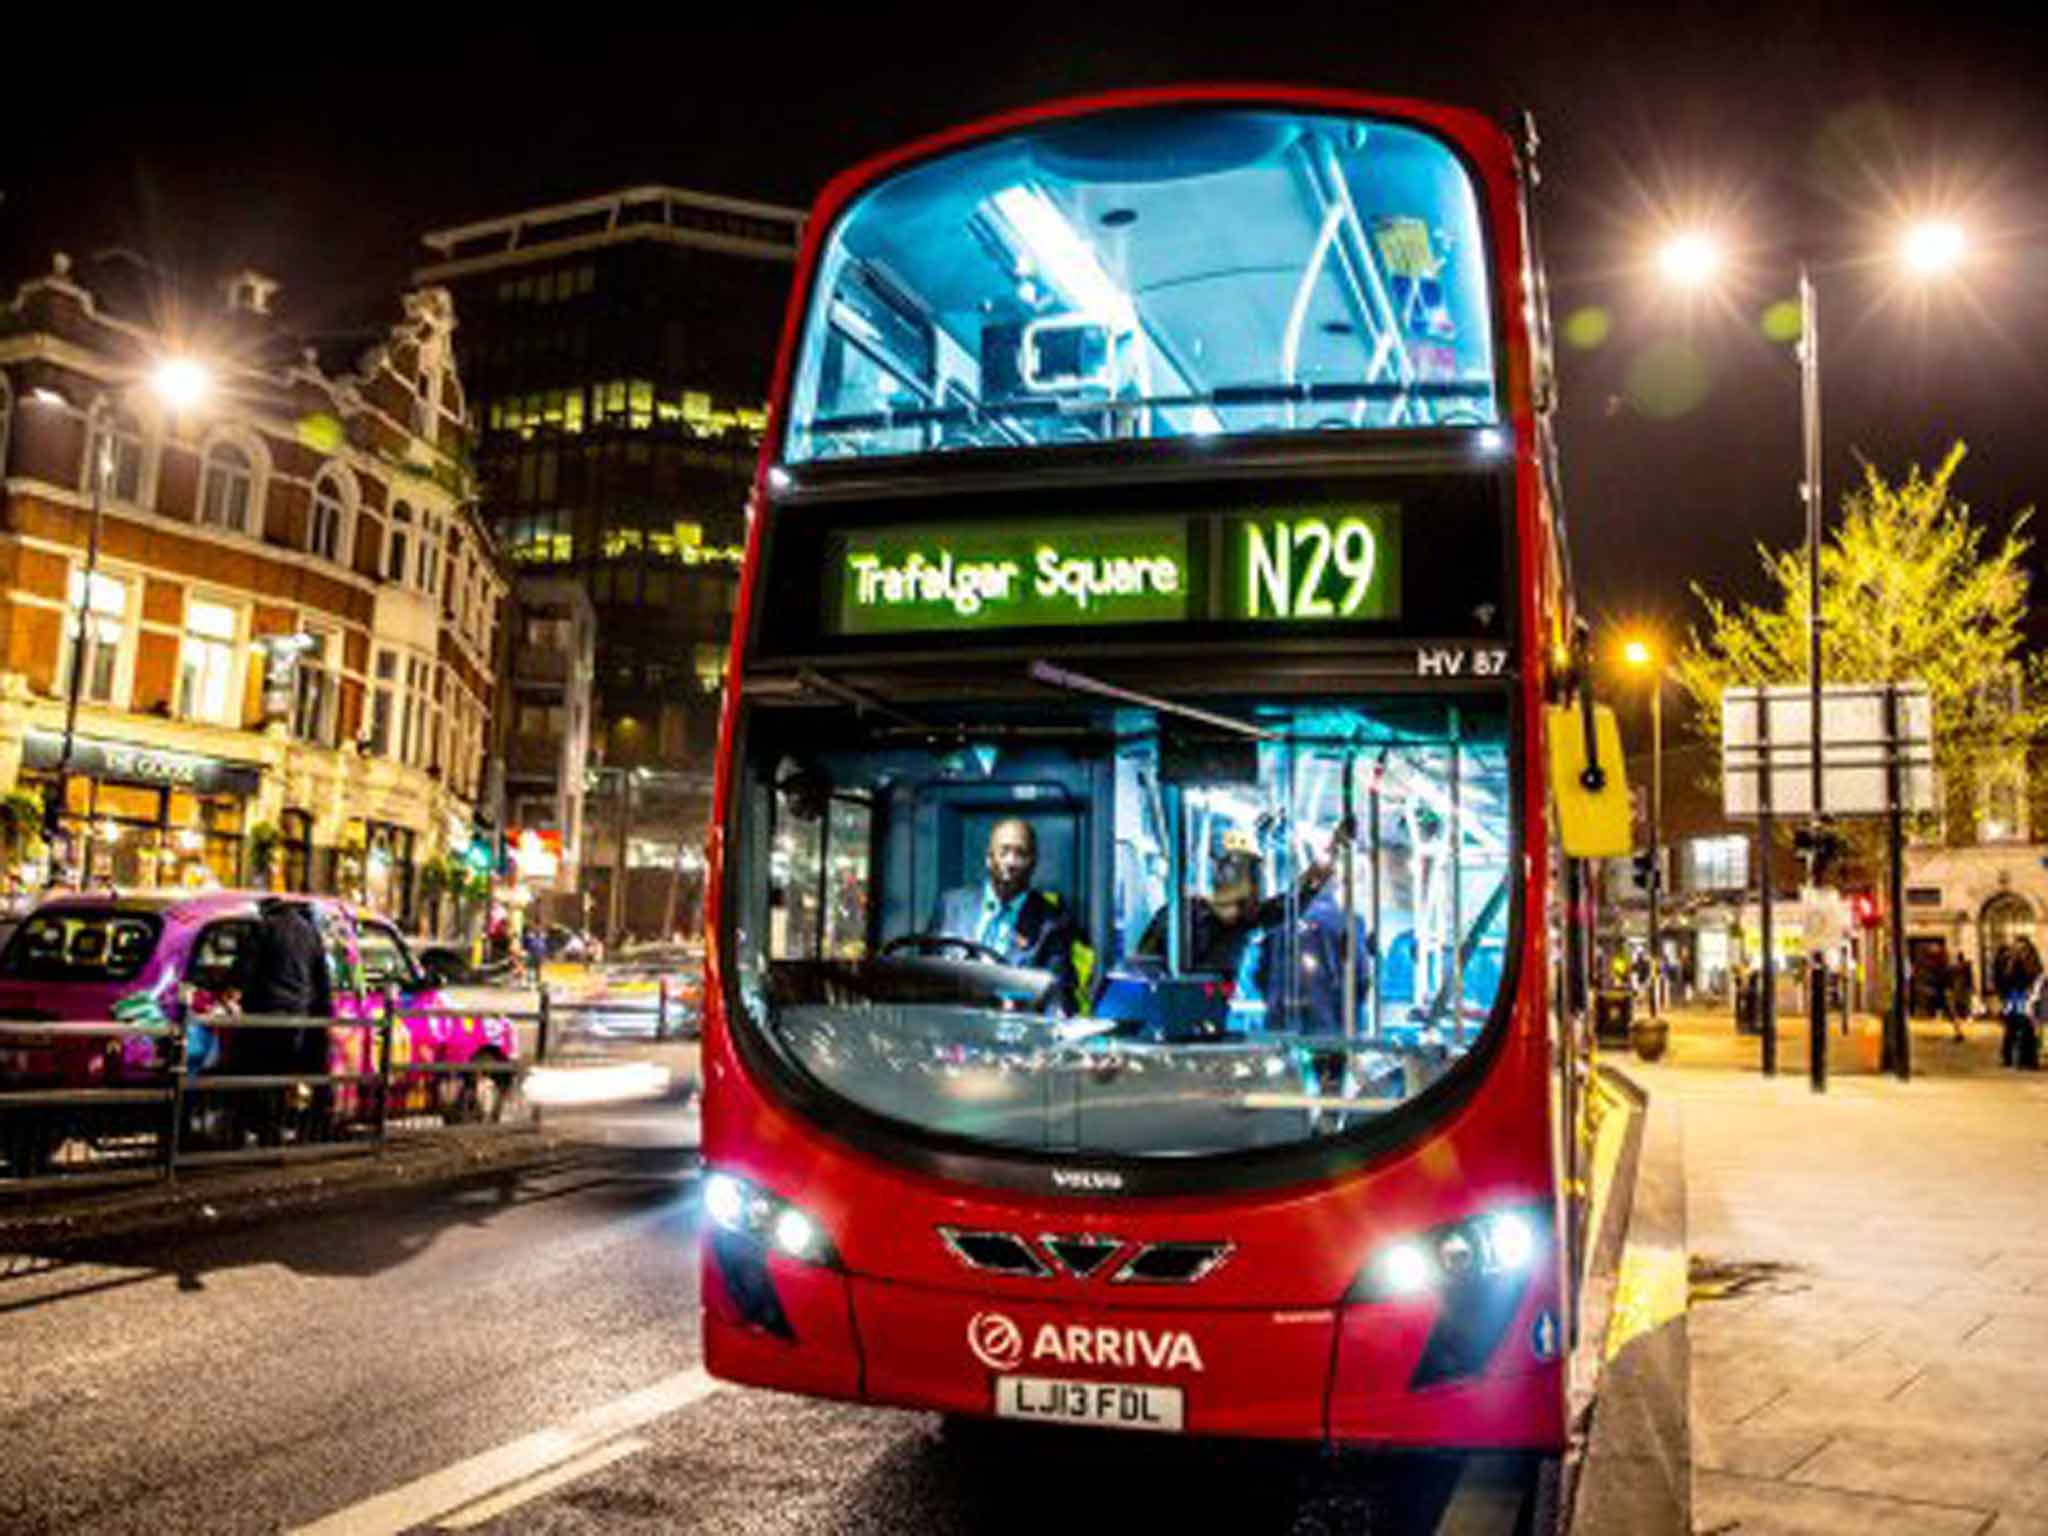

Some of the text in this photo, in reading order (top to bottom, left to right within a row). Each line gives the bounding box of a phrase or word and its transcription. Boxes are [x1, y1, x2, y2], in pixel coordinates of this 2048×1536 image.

[849, 518, 1377, 618] Trafalgar Square N29
[1417, 648, 1464, 676] HV
[1032, 1323, 1204, 1372] ARRIVA
[1015, 1377, 1161, 1423] LJ13 FDL
